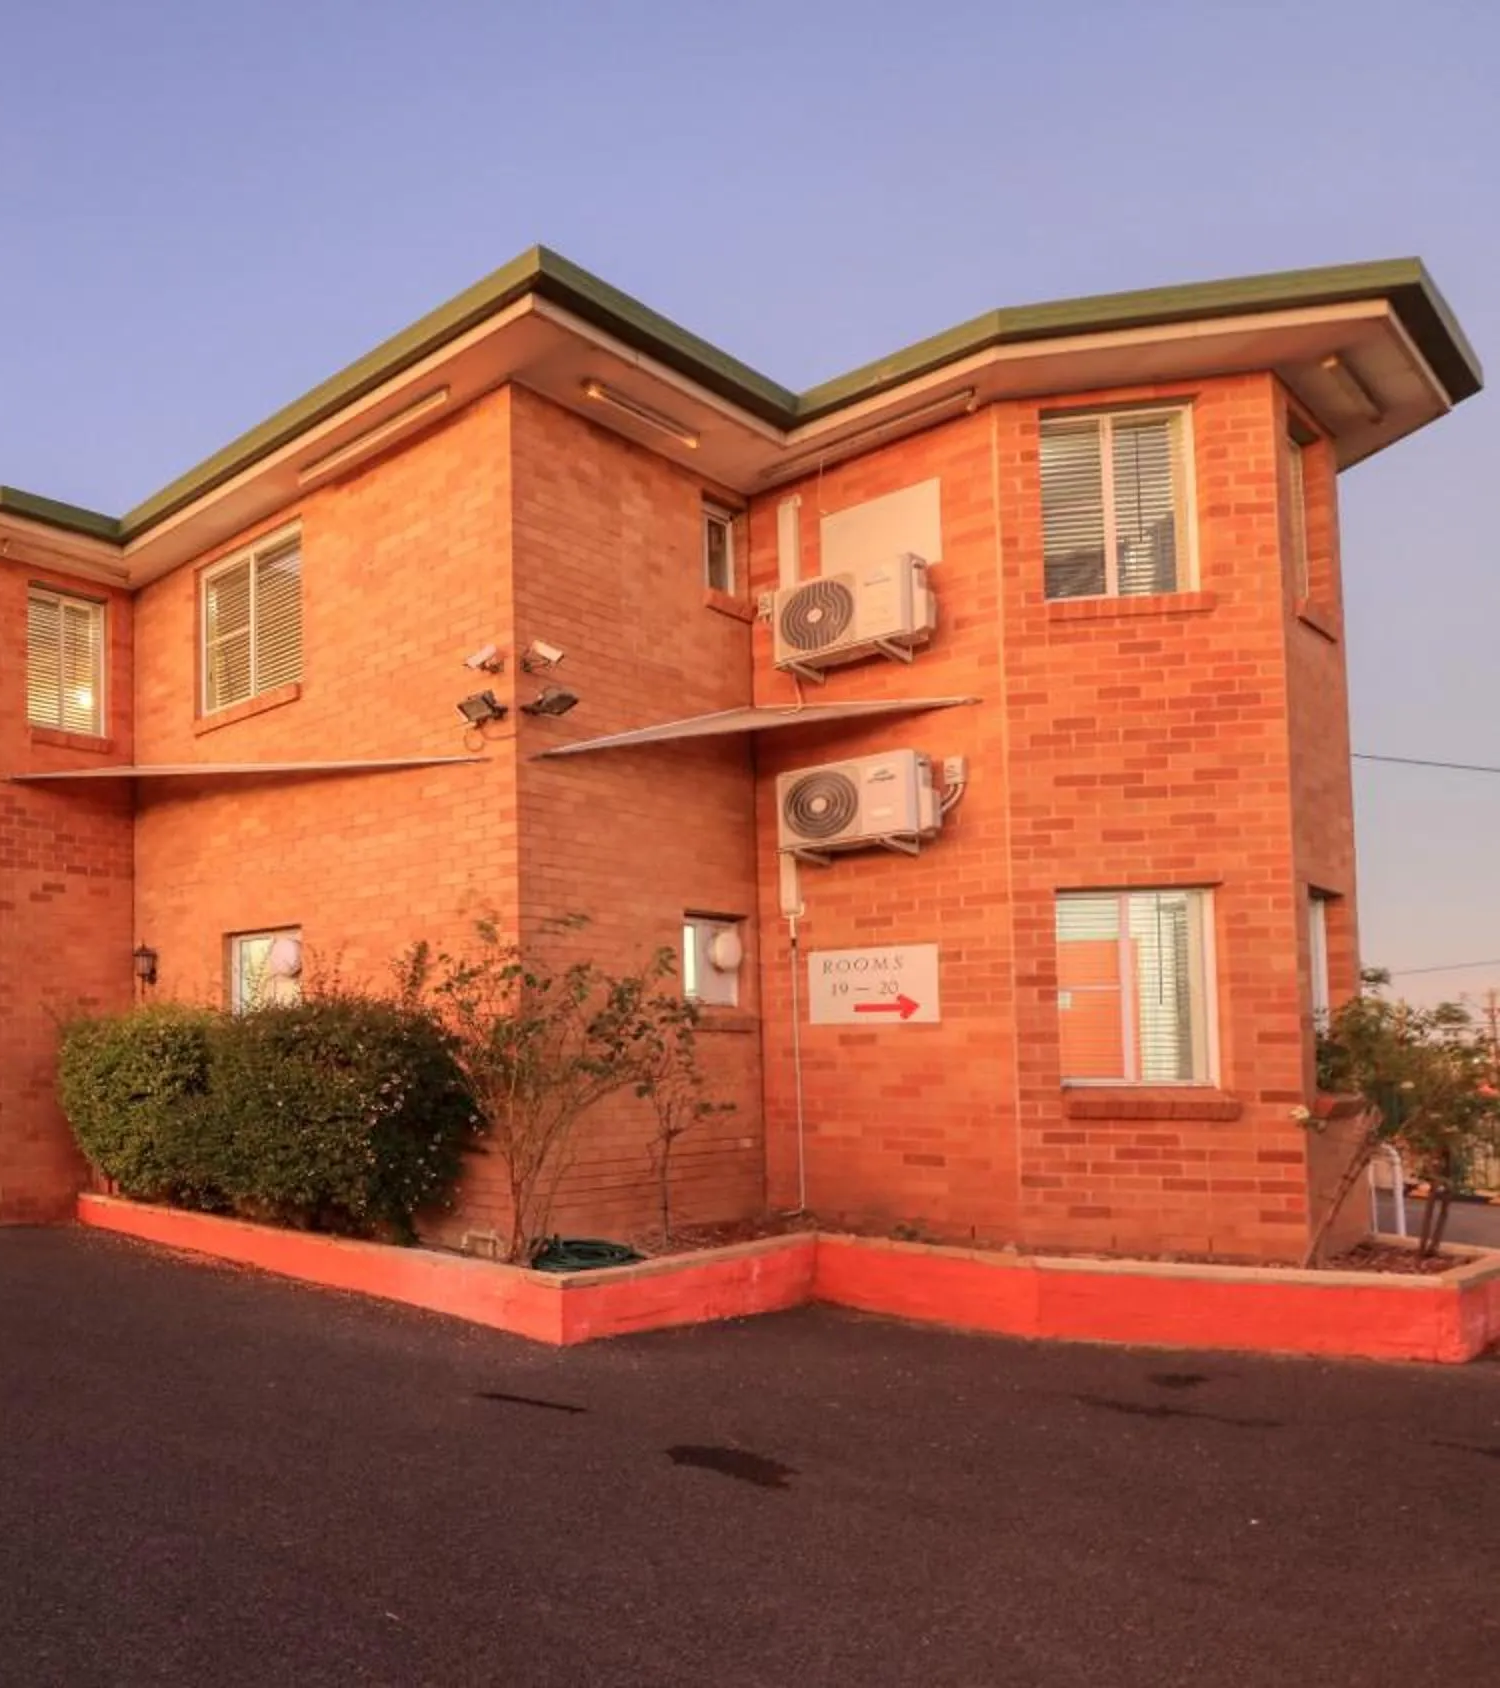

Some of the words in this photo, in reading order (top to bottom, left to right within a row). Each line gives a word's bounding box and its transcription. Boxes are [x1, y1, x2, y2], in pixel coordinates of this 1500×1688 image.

[823, 956, 904, 975] ROOMS
[832, 981, 849, 997] 19
[879, 980, 899, 995] 20
